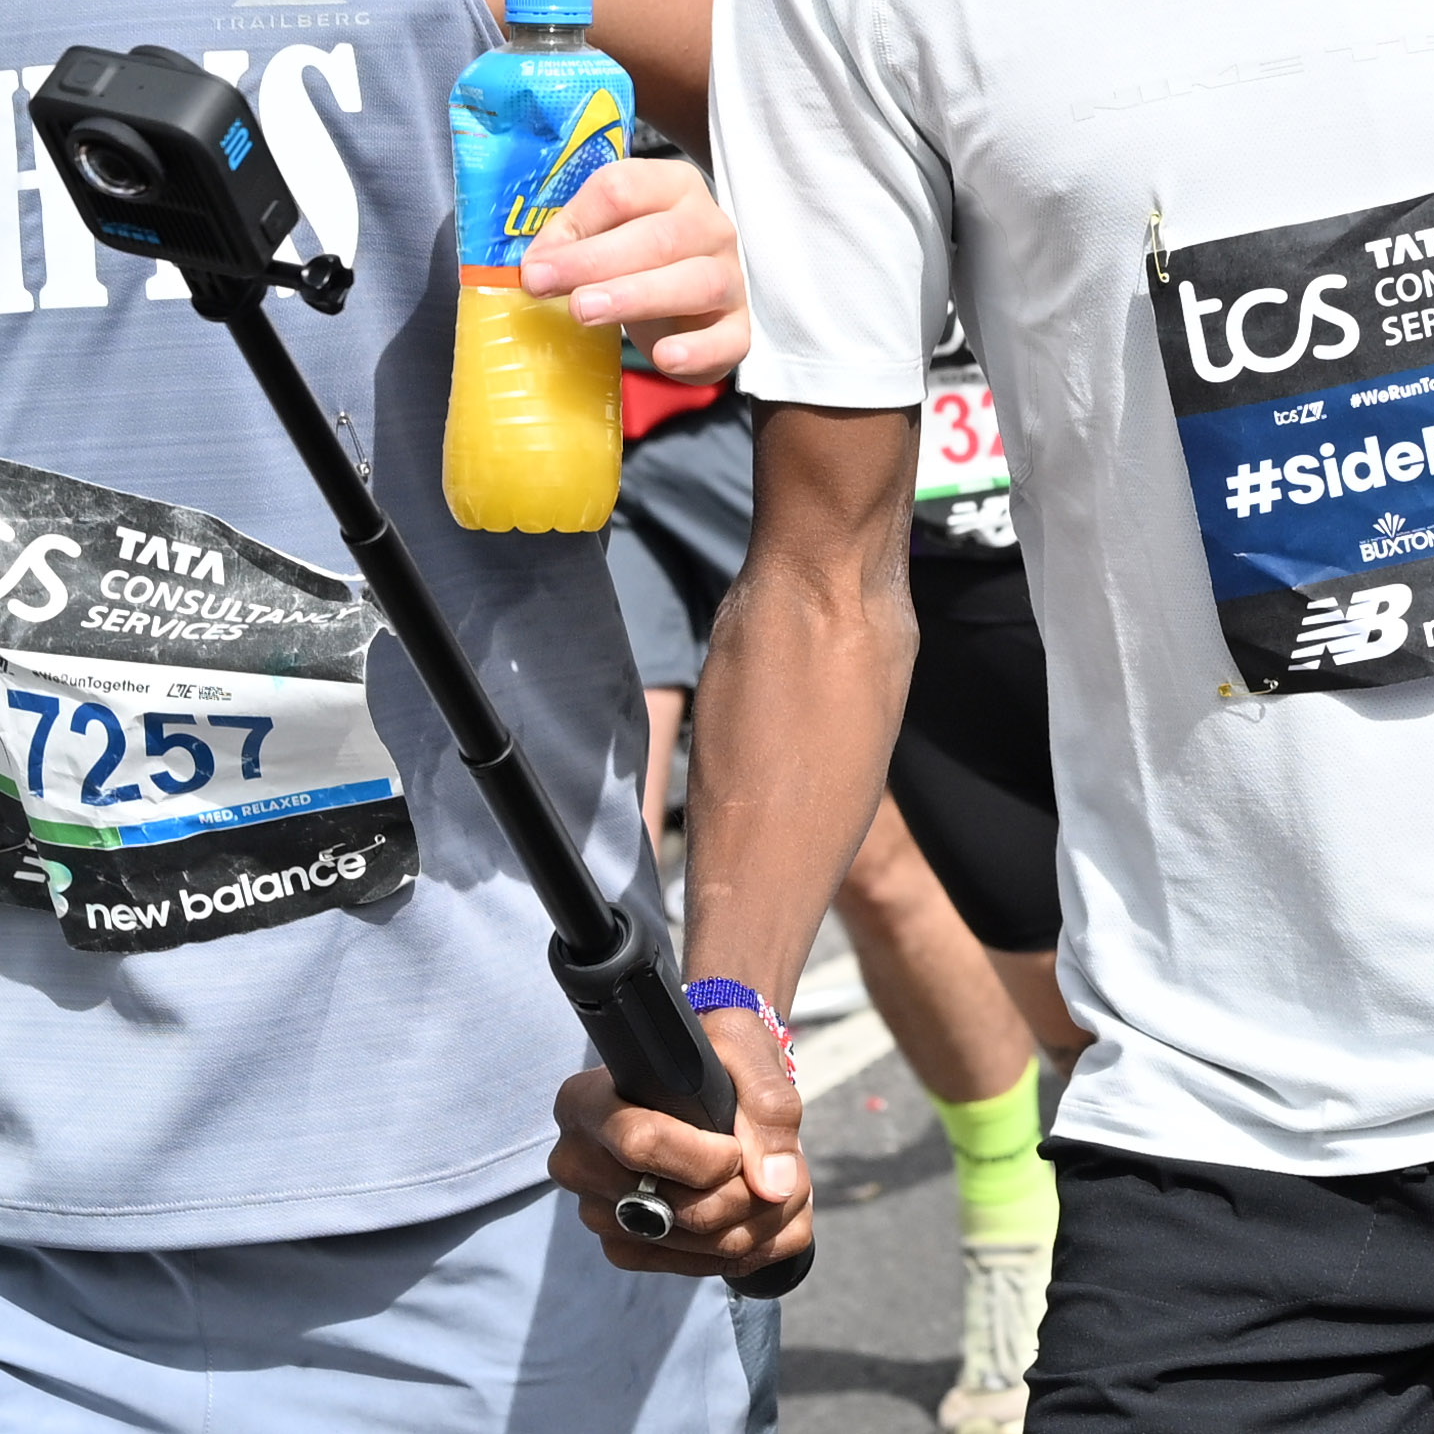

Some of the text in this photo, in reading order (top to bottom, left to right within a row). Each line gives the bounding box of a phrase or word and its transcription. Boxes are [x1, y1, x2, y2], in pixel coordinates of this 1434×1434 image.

[215, 11, 371, 31] TRAILBERG
[1179, 274, 1360, 383] tcs
[115, 525, 226, 586] TATA
[80, 605, 249, 642] SERVICES
[100, 569, 364, 625] CONSULTANCY
[242, 794, 312, 818] RELAXED
[86, 852, 367, 932] new balance
